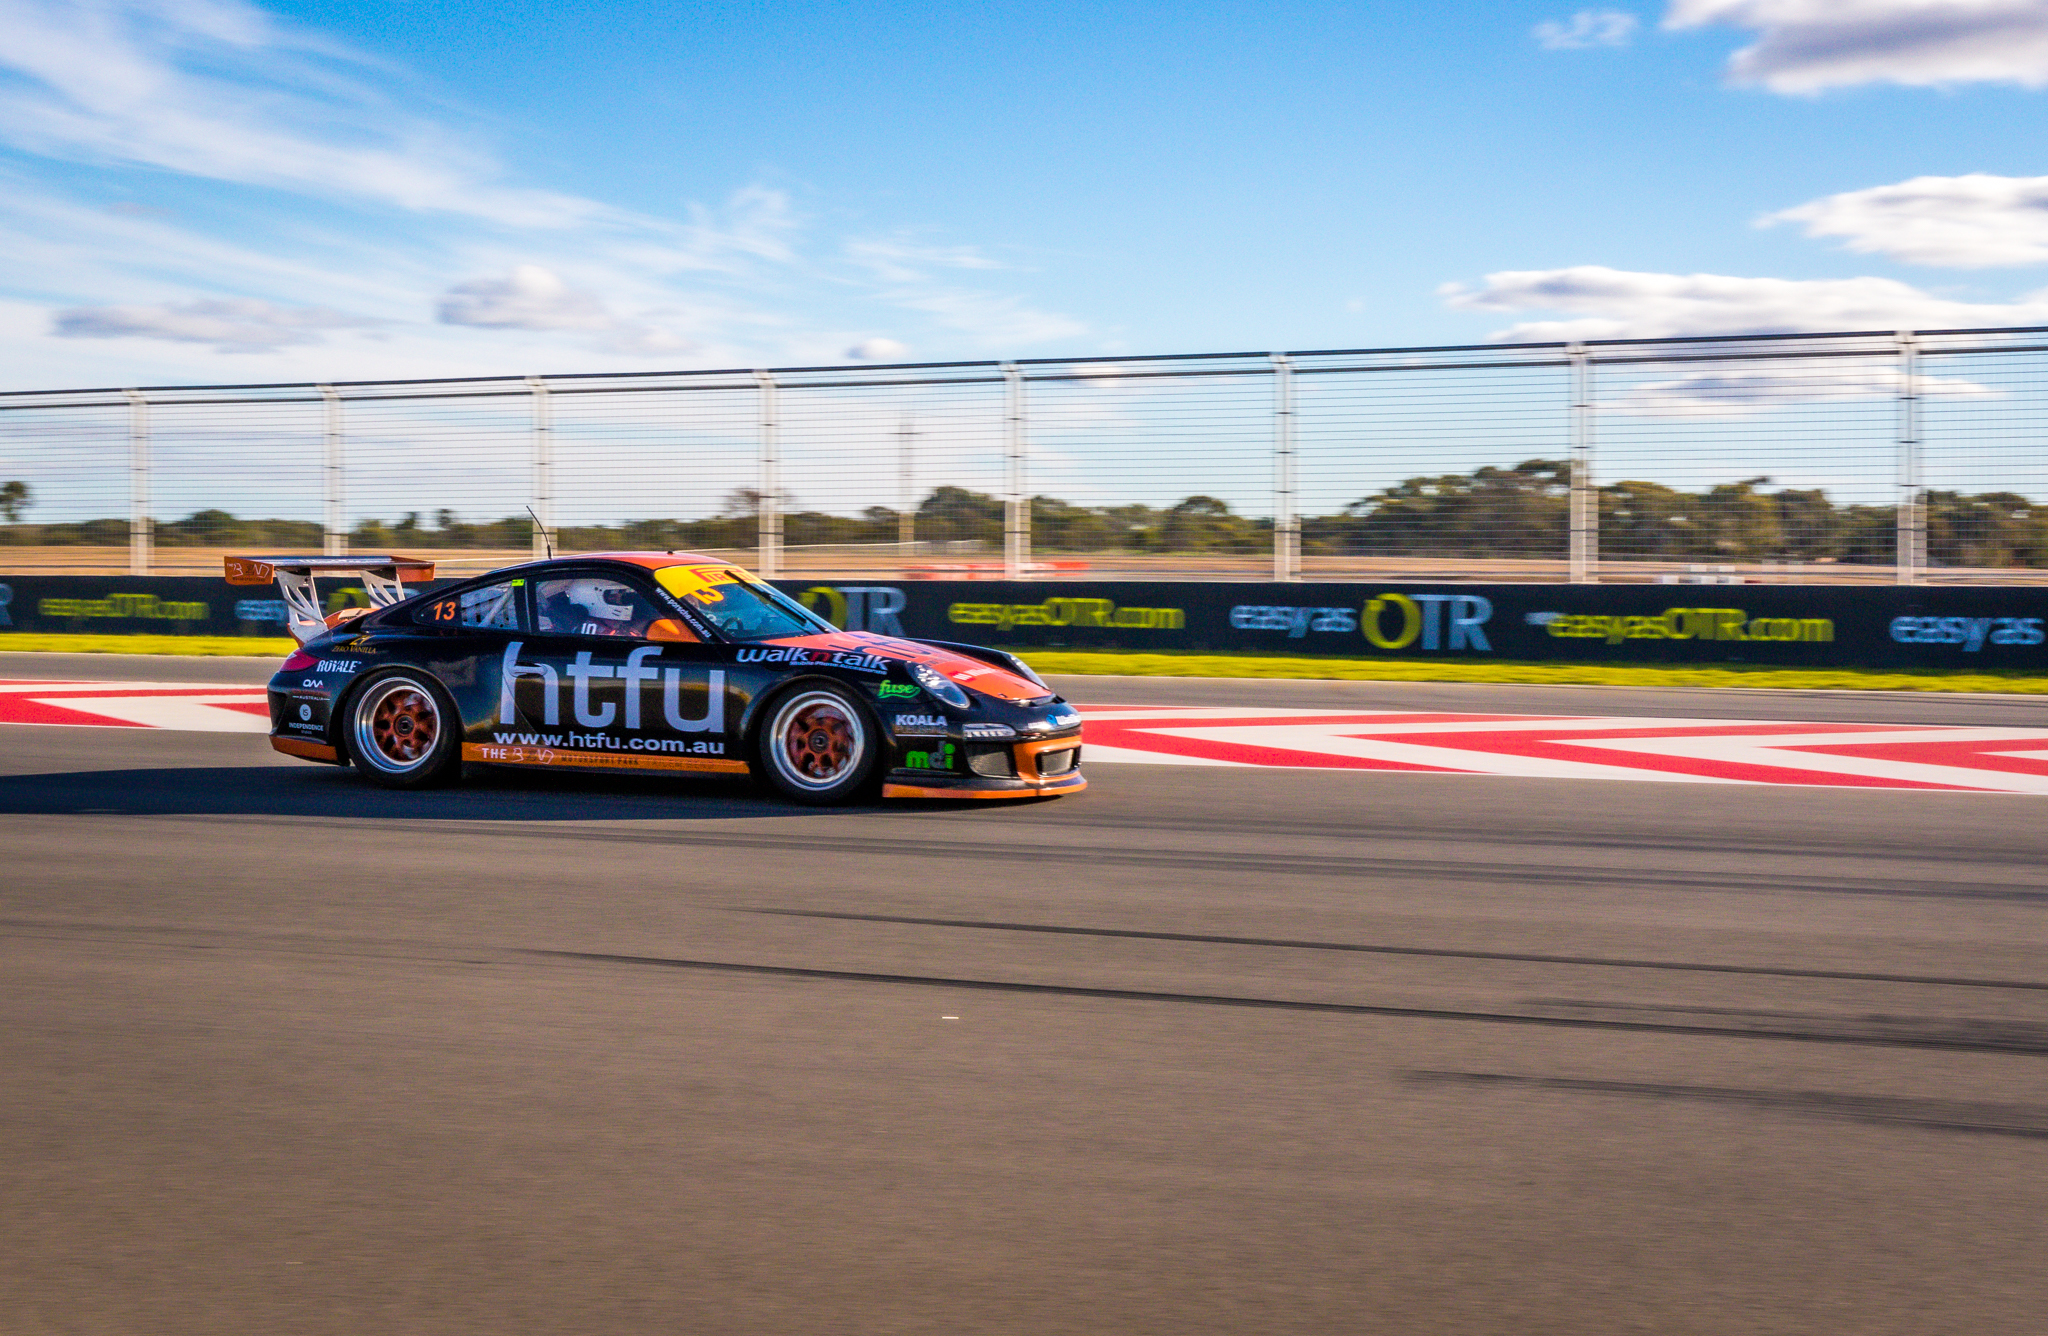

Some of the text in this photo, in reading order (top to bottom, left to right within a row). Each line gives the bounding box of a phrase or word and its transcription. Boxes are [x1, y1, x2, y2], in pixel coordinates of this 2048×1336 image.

[433, 601, 456, 621] 13
[947, 597, 1185, 631] easyasOTR.com
[1229, 592, 1494, 651] easyas OTR
[1546, 607, 1835, 645] easyasOTR.com
[1889, 616, 2047, 652] easyas
[500, 641, 725, 733] htfu
[878, 679, 920, 697] fuse
[288, 722, 324, 732] INDEPENDENCE
[895, 714, 948, 727] KOALA
[481, 748, 507, 760] THE
[493, 731, 725, 755] www.htfu.com.au
[905, 741, 956, 770] mdi
